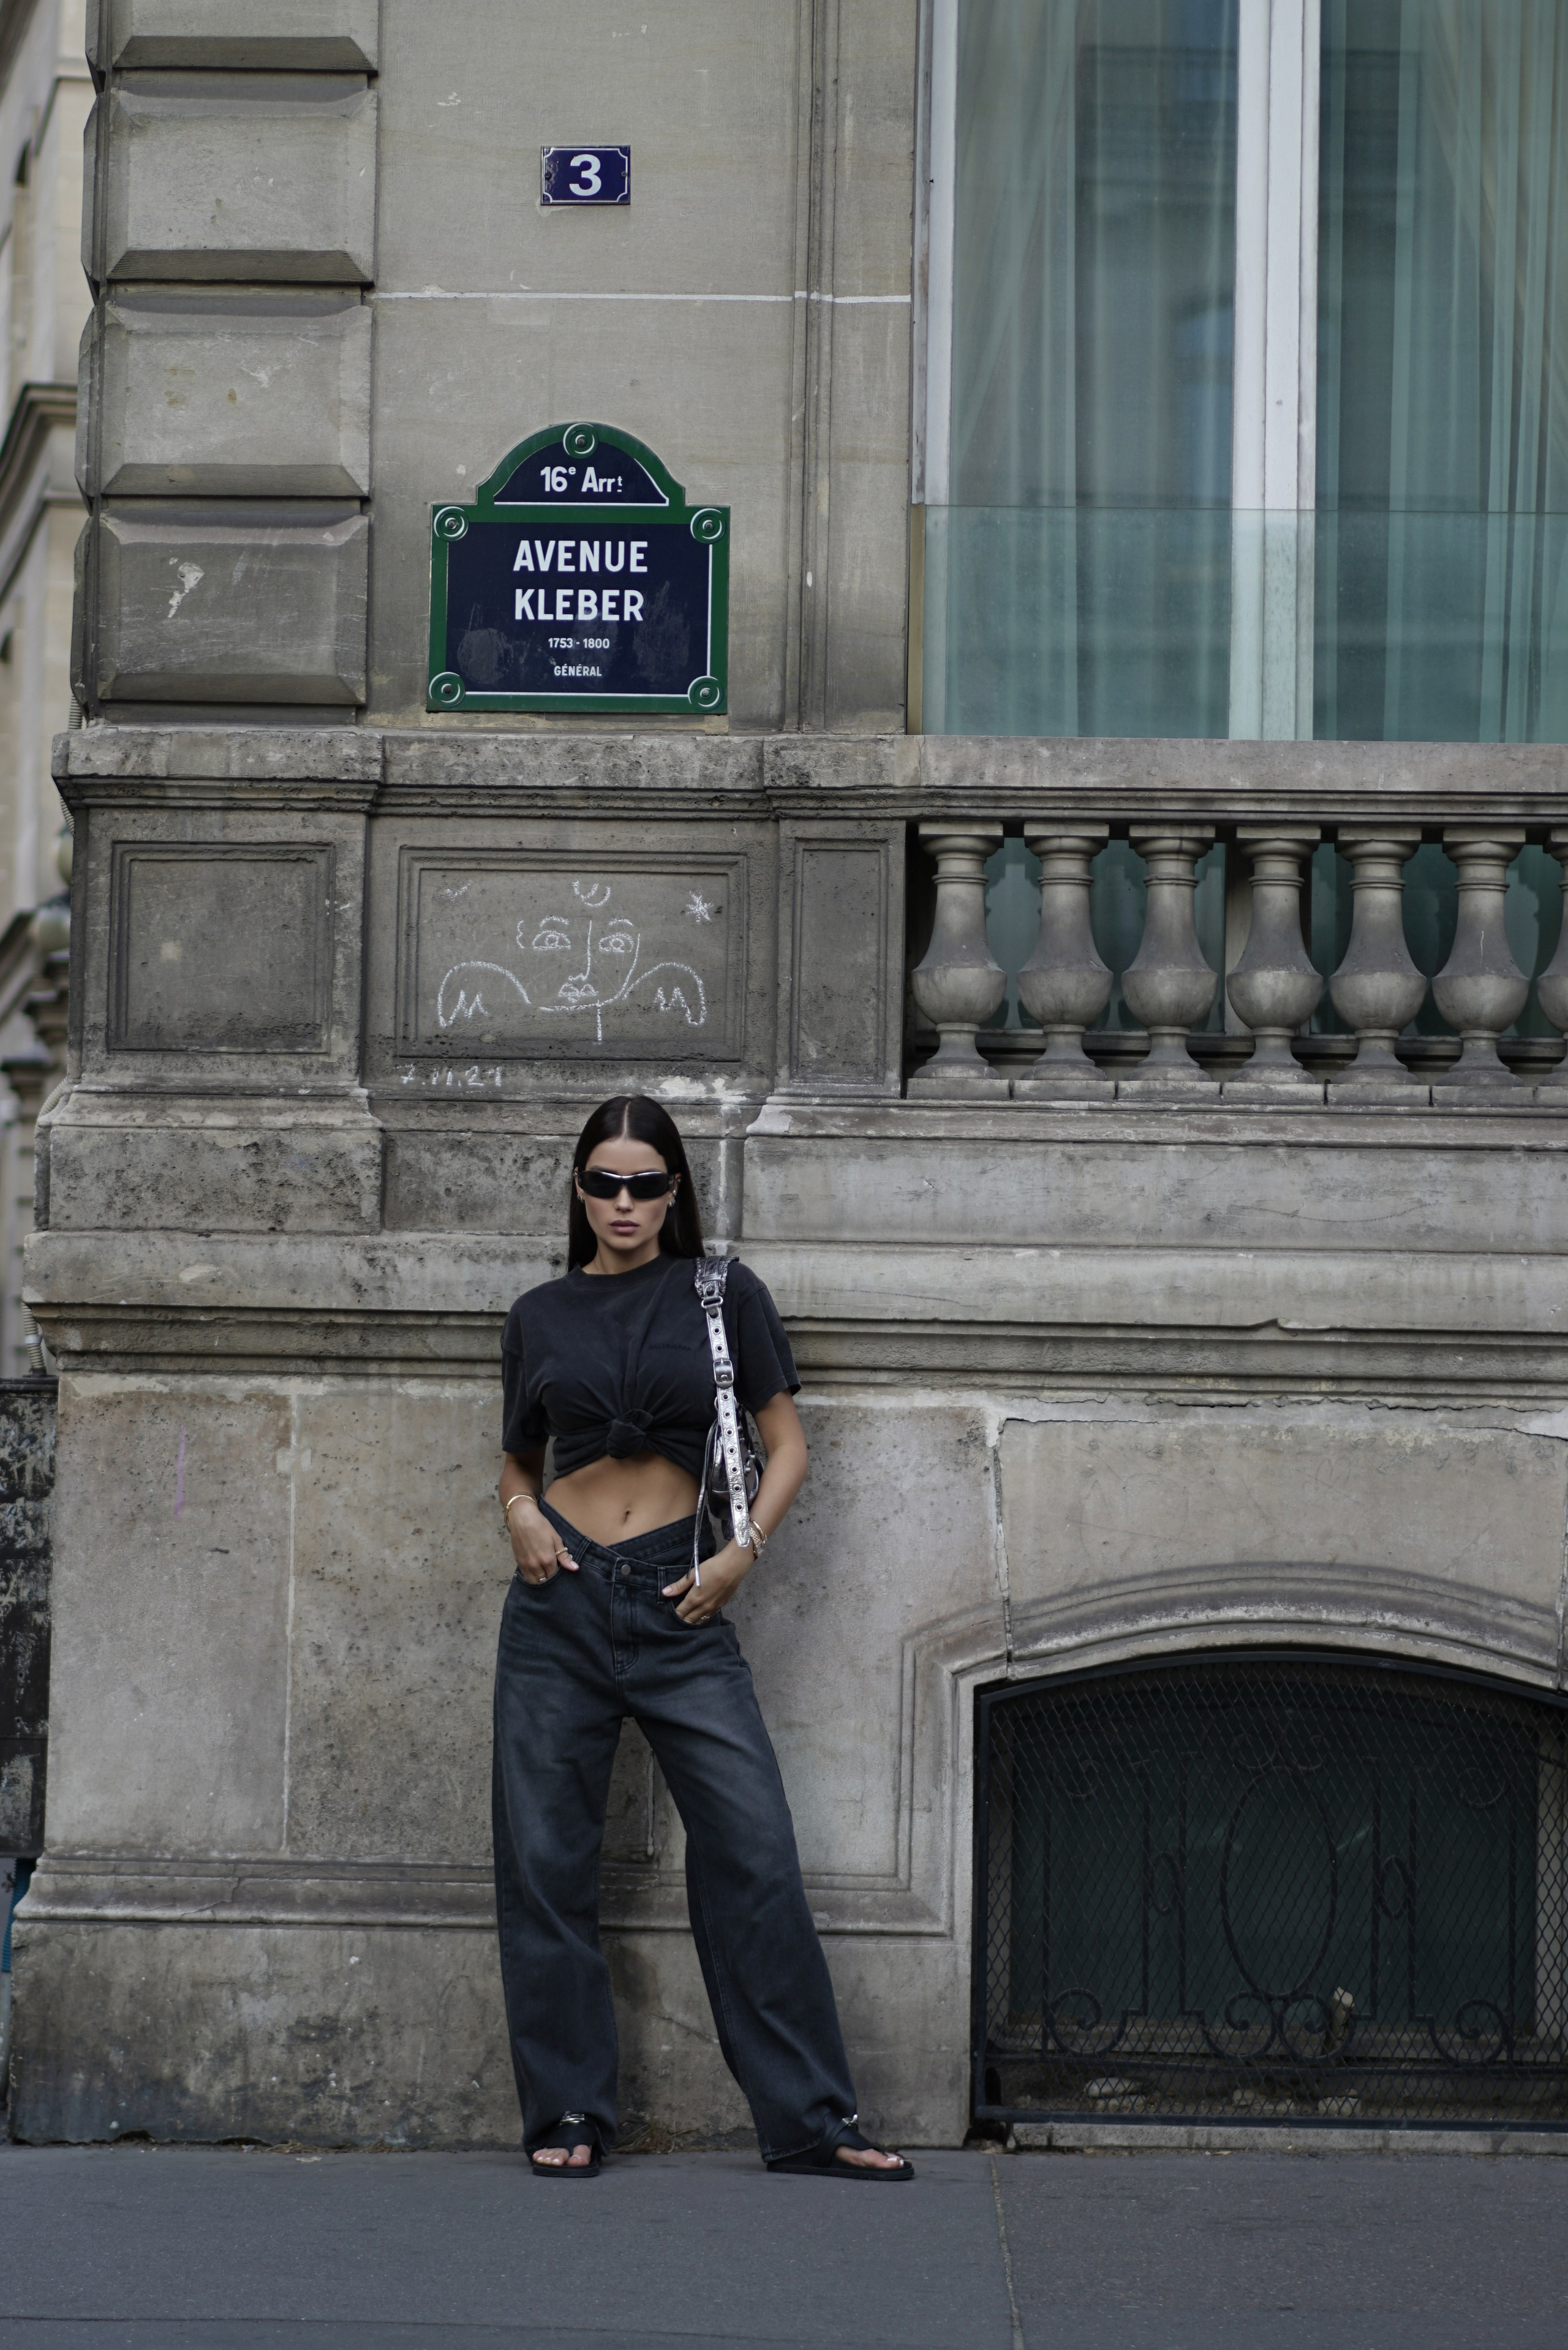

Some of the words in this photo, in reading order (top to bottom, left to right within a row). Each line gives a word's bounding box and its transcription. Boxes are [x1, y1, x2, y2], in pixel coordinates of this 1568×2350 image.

[569, 154, 601, 196] 3
[513, 540, 648, 572] AVENUE
[515, 589, 644, 621] KLEBER
[548, 638, 573, 649] 1753
[583, 638, 610, 649] 1800
[554, 663, 602, 676] GÉNÉRAL
